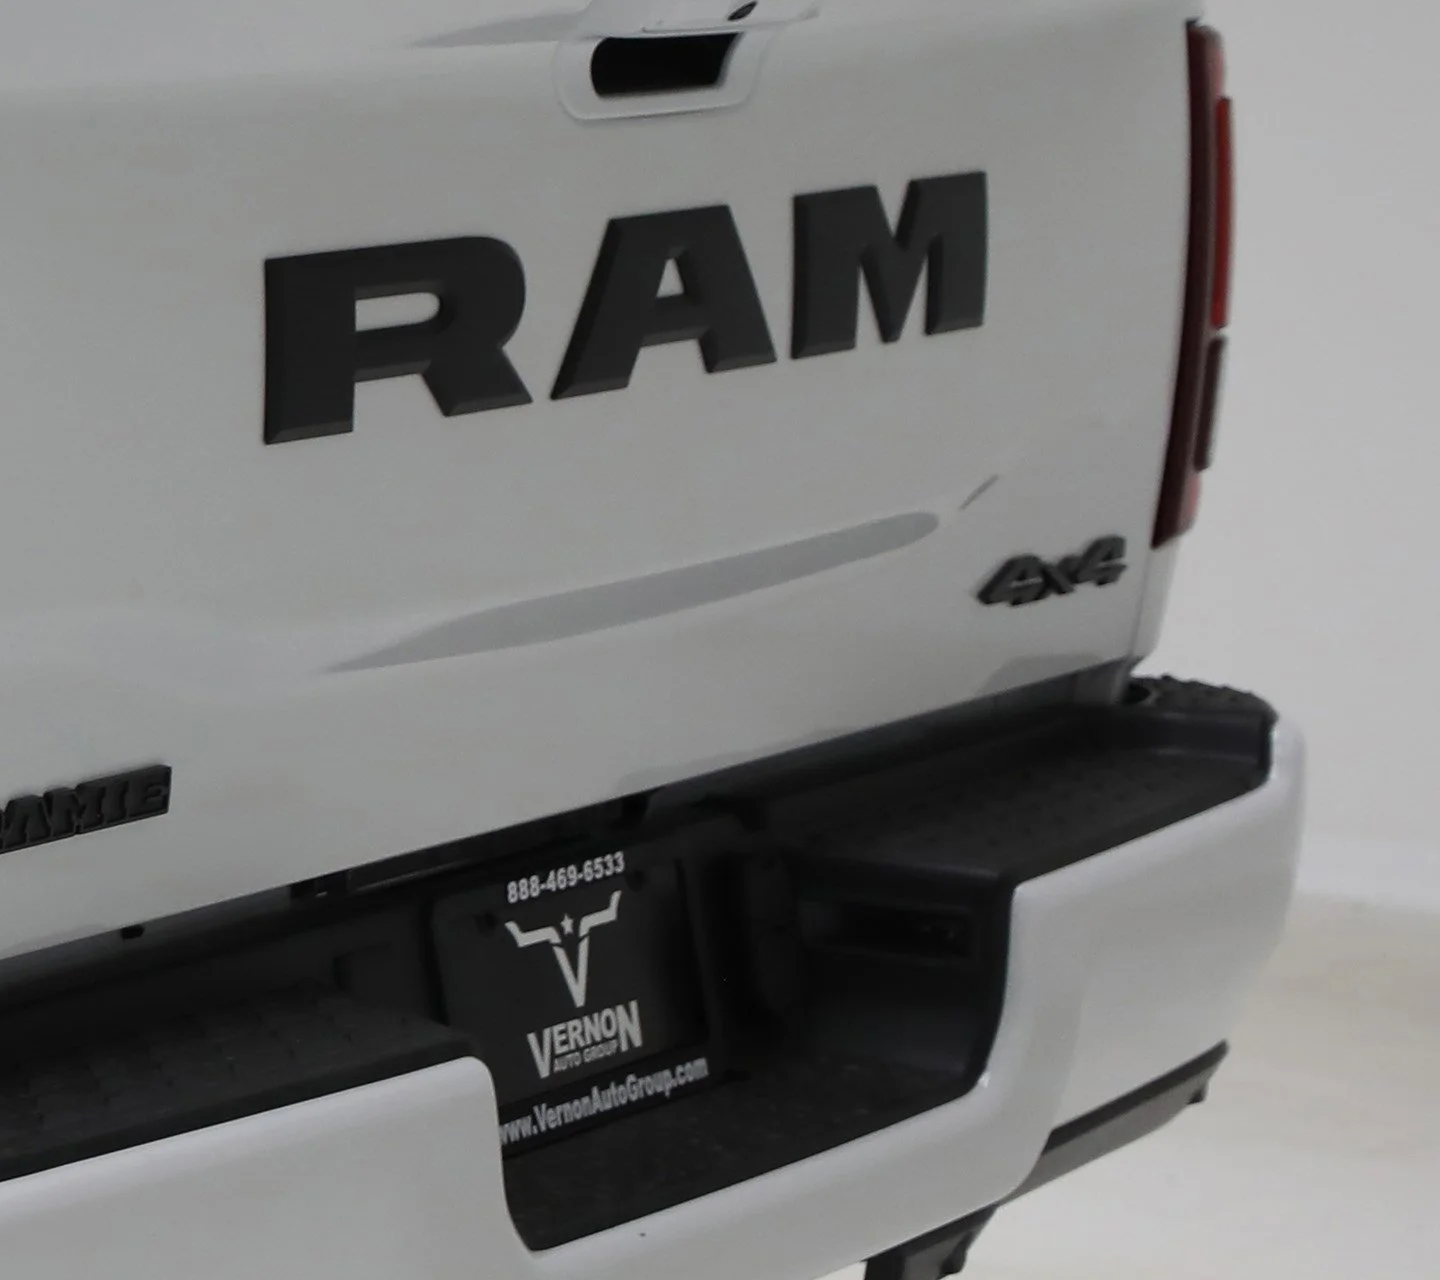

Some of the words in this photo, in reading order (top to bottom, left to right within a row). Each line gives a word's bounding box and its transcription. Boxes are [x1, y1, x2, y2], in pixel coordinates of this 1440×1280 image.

[264, 171, 987, 445] RAM
[976, 533, 1128, 606] 4x4
[506, 850, 626, 904] 888-469-6533
[527, 999, 643, 1079] VERNON
[552, 1051, 582, 1072] AUTO
